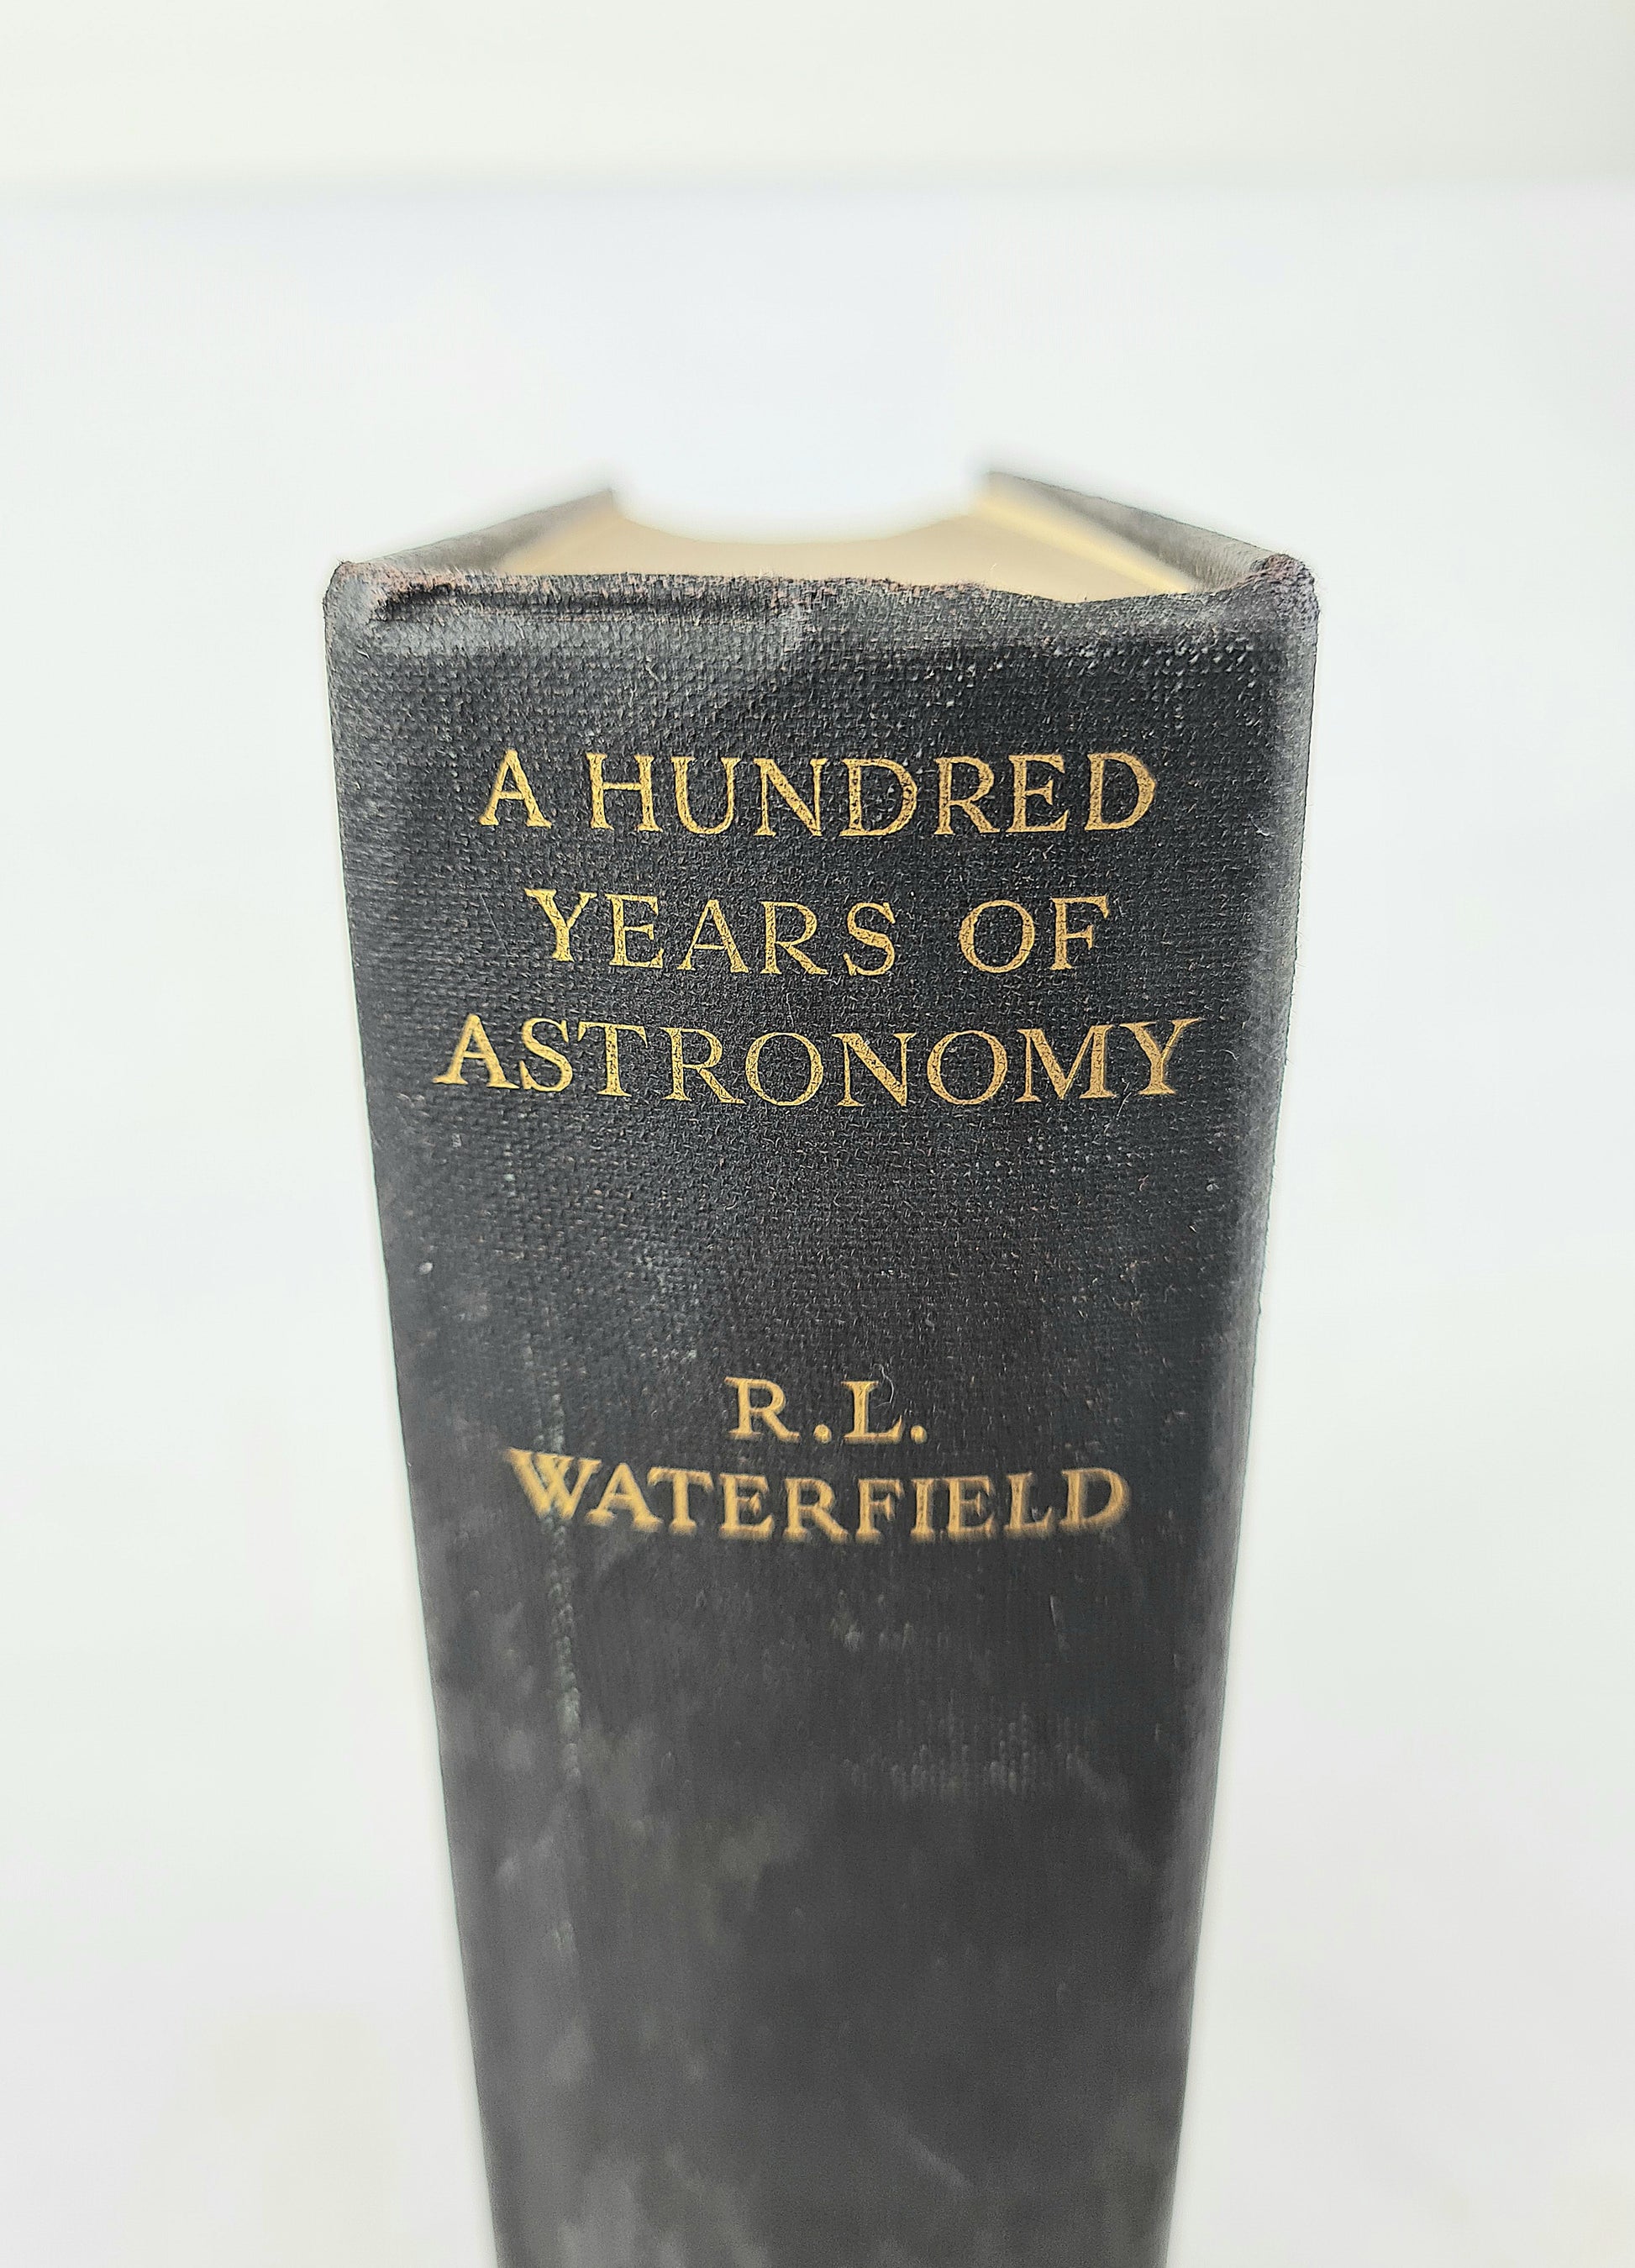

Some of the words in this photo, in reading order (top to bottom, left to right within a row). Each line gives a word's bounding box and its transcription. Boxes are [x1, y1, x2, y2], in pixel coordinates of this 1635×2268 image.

[478, 748, 553, 829] A
[586, 751, 1158, 838] HUNDRED
[524, 887, 896, 977] YEARS
[958, 894, 1111, 975] OF
[432, 1013, 1202, 1108] ASTRONOMY
[507, 1447, 1130, 1542] WATERFIELD
